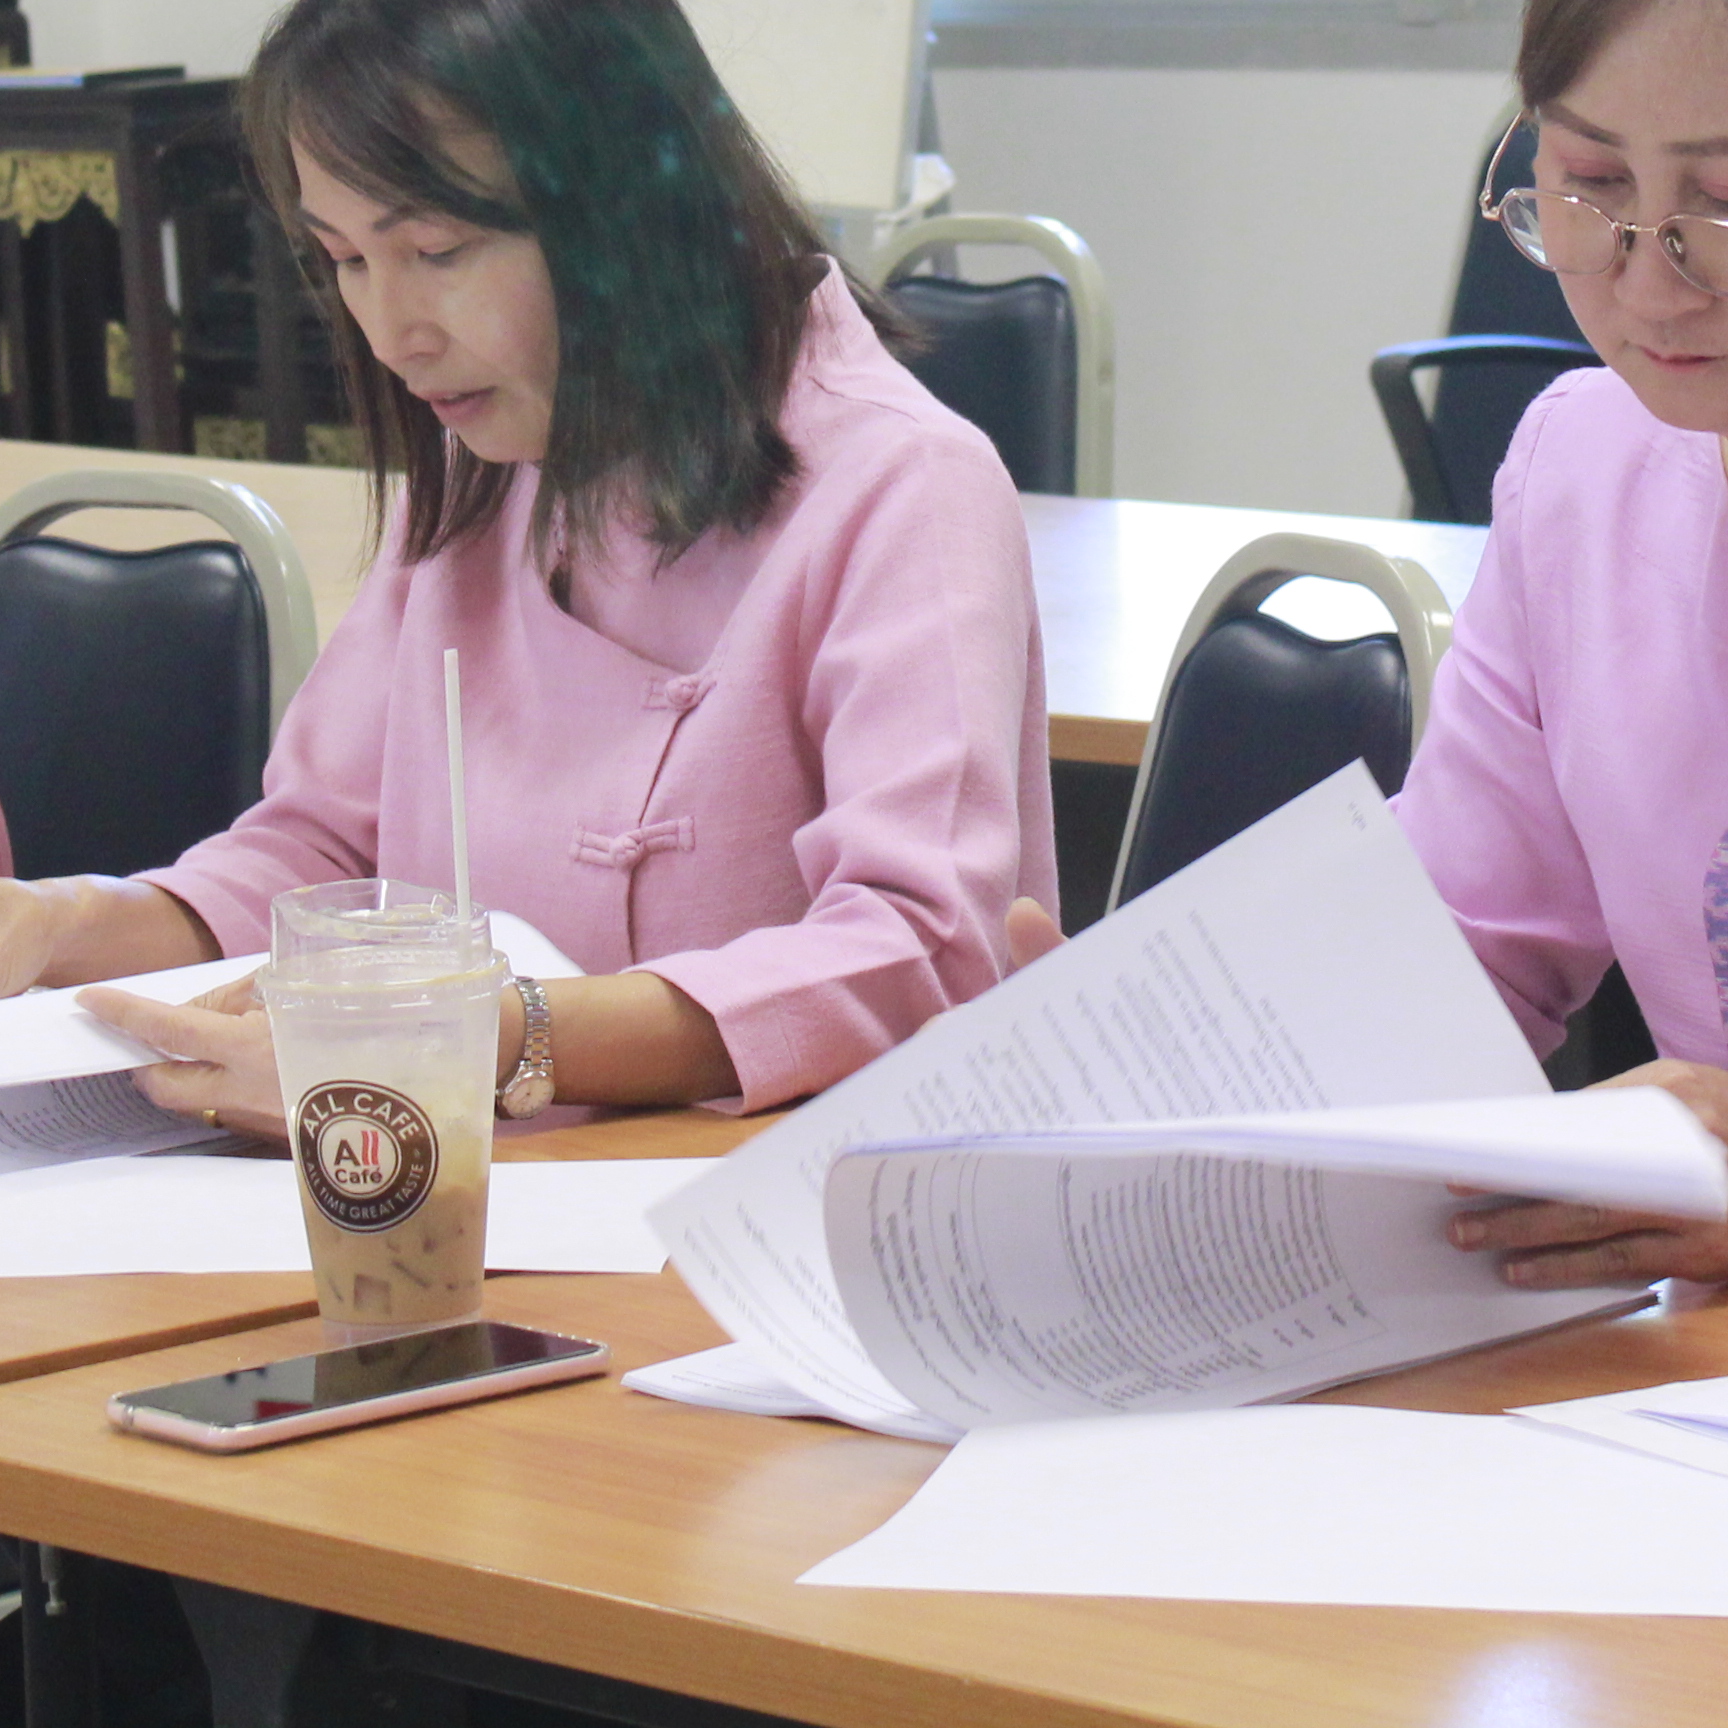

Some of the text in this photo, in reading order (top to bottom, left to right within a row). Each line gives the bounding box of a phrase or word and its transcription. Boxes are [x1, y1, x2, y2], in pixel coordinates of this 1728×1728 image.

[303, 1092, 420, 1141] ALL CAFE
[334, 1130, 380, 1167] All
[306, 1163, 424, 1220] ALL TIME GREAT TASTE
[334, 1167, 383, 1185] Café
